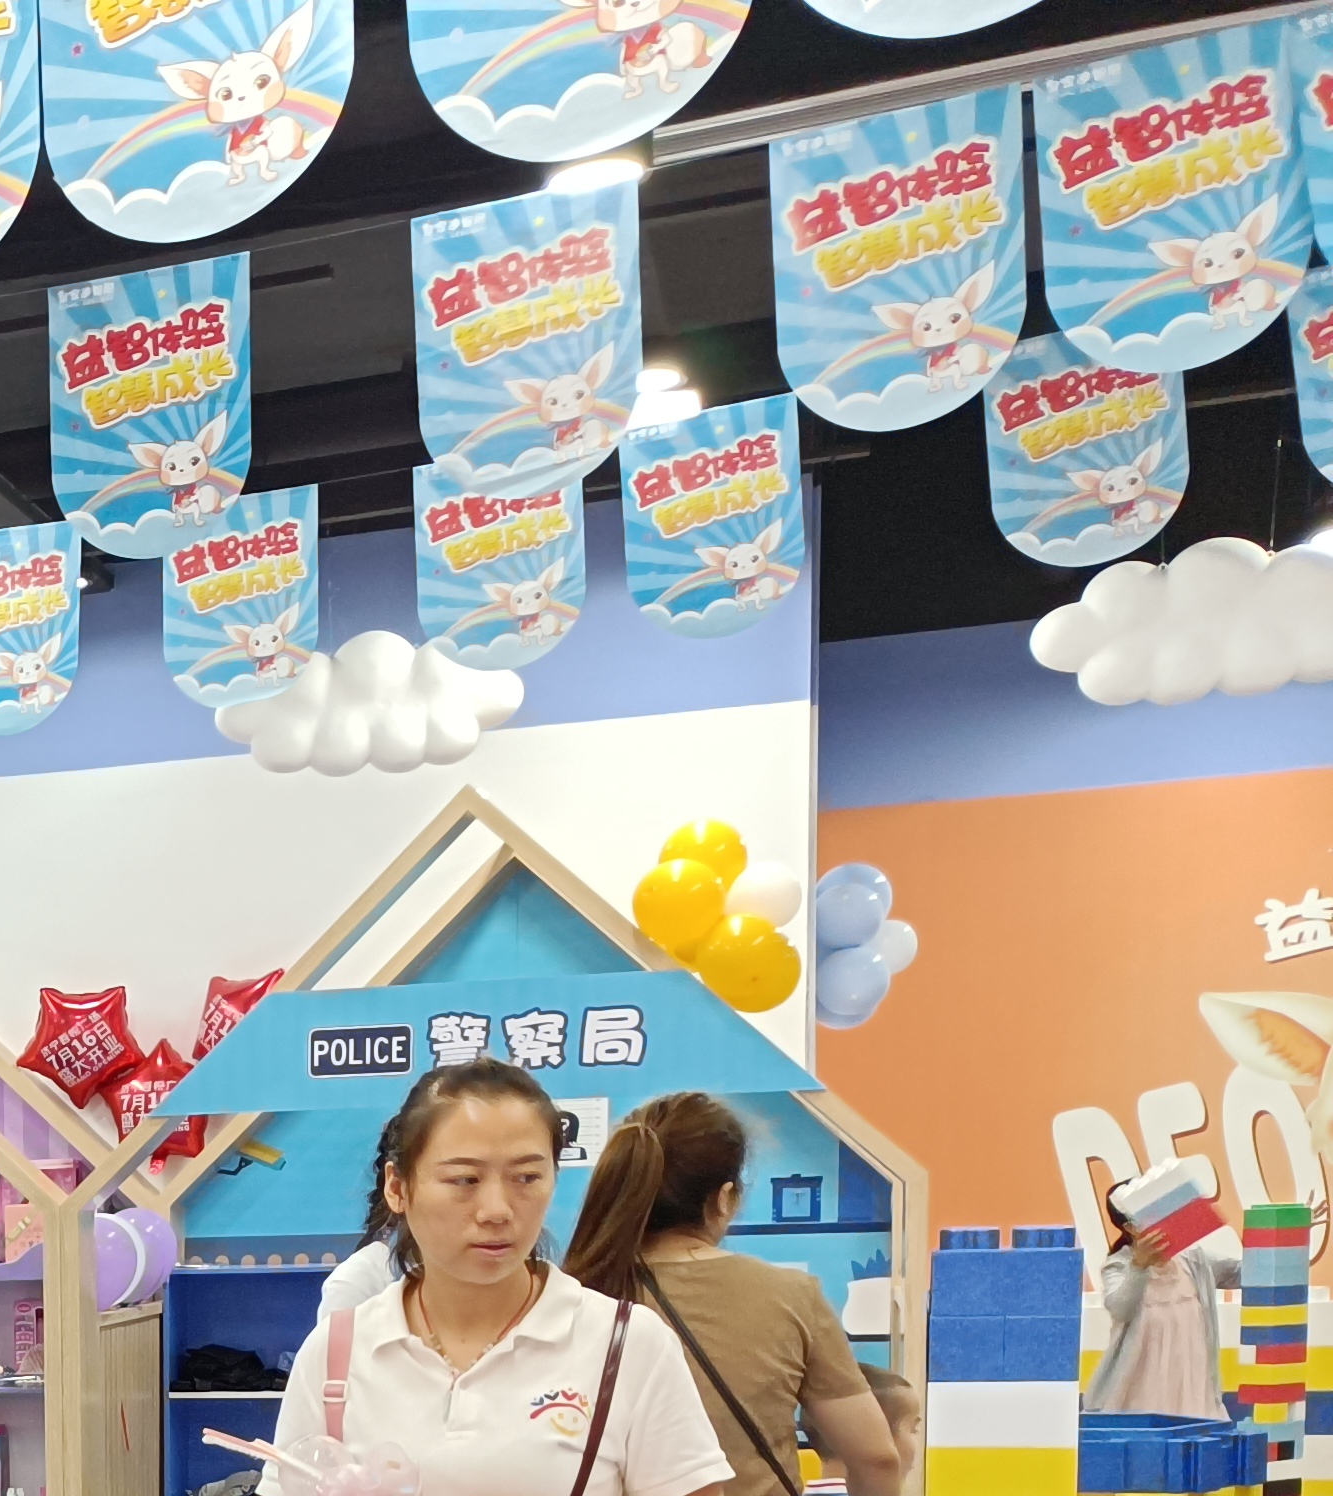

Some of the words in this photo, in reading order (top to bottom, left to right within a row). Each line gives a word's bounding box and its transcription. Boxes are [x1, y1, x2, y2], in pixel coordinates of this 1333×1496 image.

[1055, 70, 1269, 188] 益智体验
[789, 143, 991, 250] 益智体验
[1087, 127, 1279, 224] 智慧成长
[817, 193, 998, 286] 智慧成长
[430, 228, 613, 326] 益智体验
[63, 304, 225, 389] 益智体验
[455, 277, 617, 361] 智慧成长
[84, 350, 232, 425] 智慧成长
[1021, 389, 1161, 458] 智慧成长
[635, 436, 776, 507] 益智体验
[655, 473, 782, 534] 智慧成长
[174, 524, 298, 583] 益智体验
[446, 511, 565, 569] 智慧成长
[190, 558, 302, 609] 智慧成长
[46, 1020, 112, 1070] 7月16日
[313, 1037, 408, 1068] POLICE
[430, 1008, 644, 1068] 警察局
